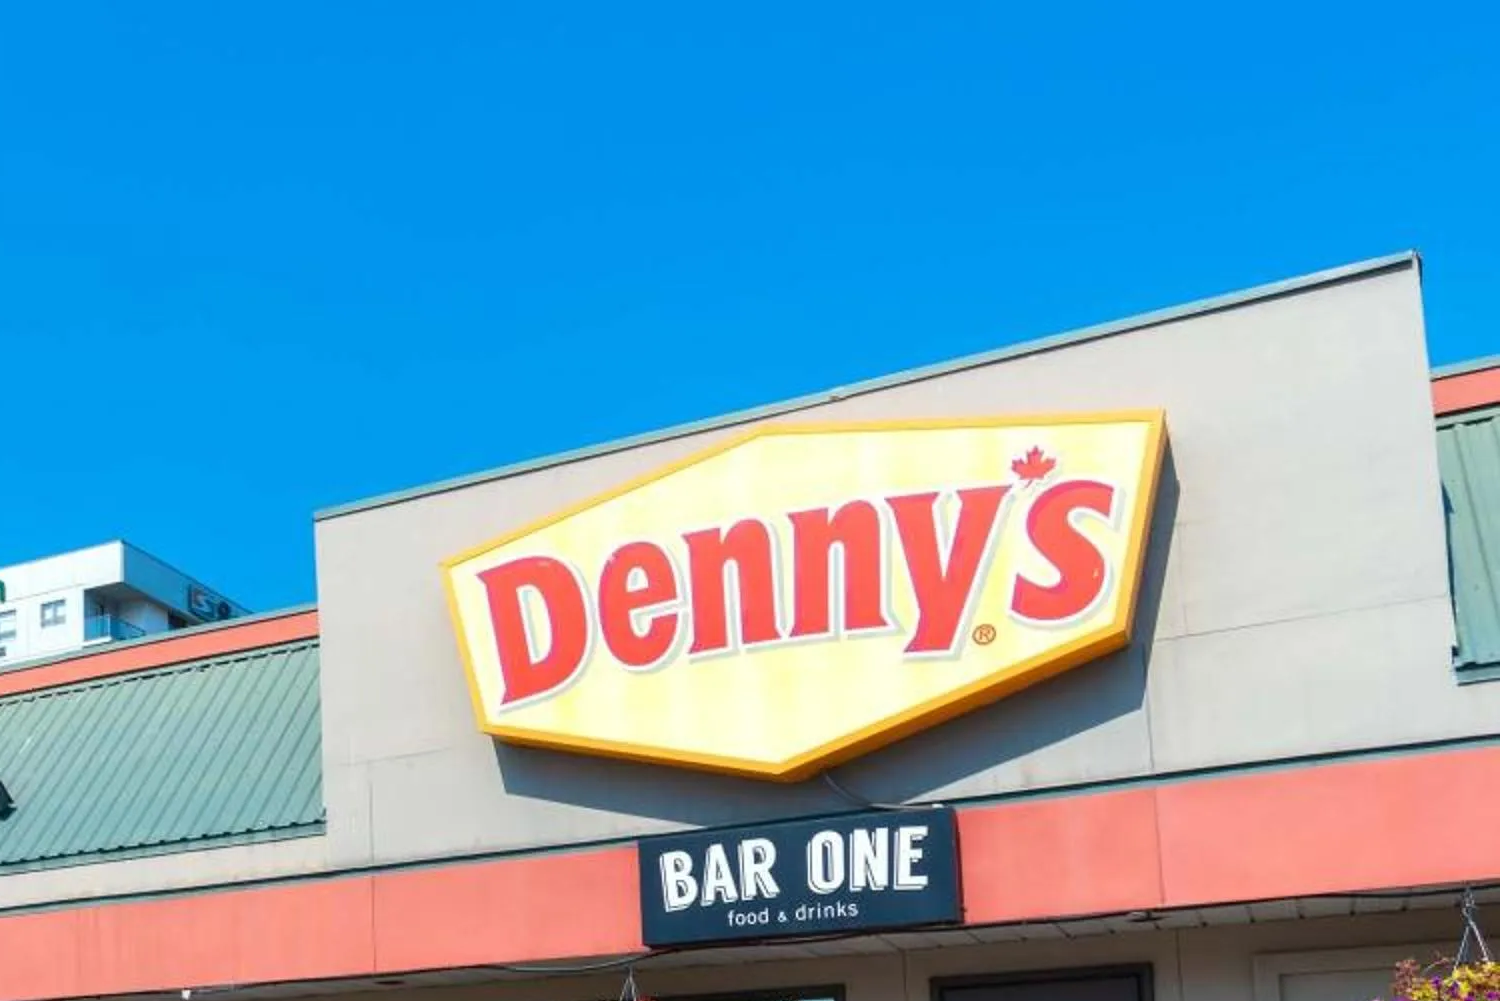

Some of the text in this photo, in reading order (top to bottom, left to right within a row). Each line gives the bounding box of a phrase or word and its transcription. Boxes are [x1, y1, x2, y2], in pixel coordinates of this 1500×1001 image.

[477, 445, 1115, 706] Denny's
[660, 825, 929, 913] BAR ONE
[728, 902, 859, 927] food & drinks
